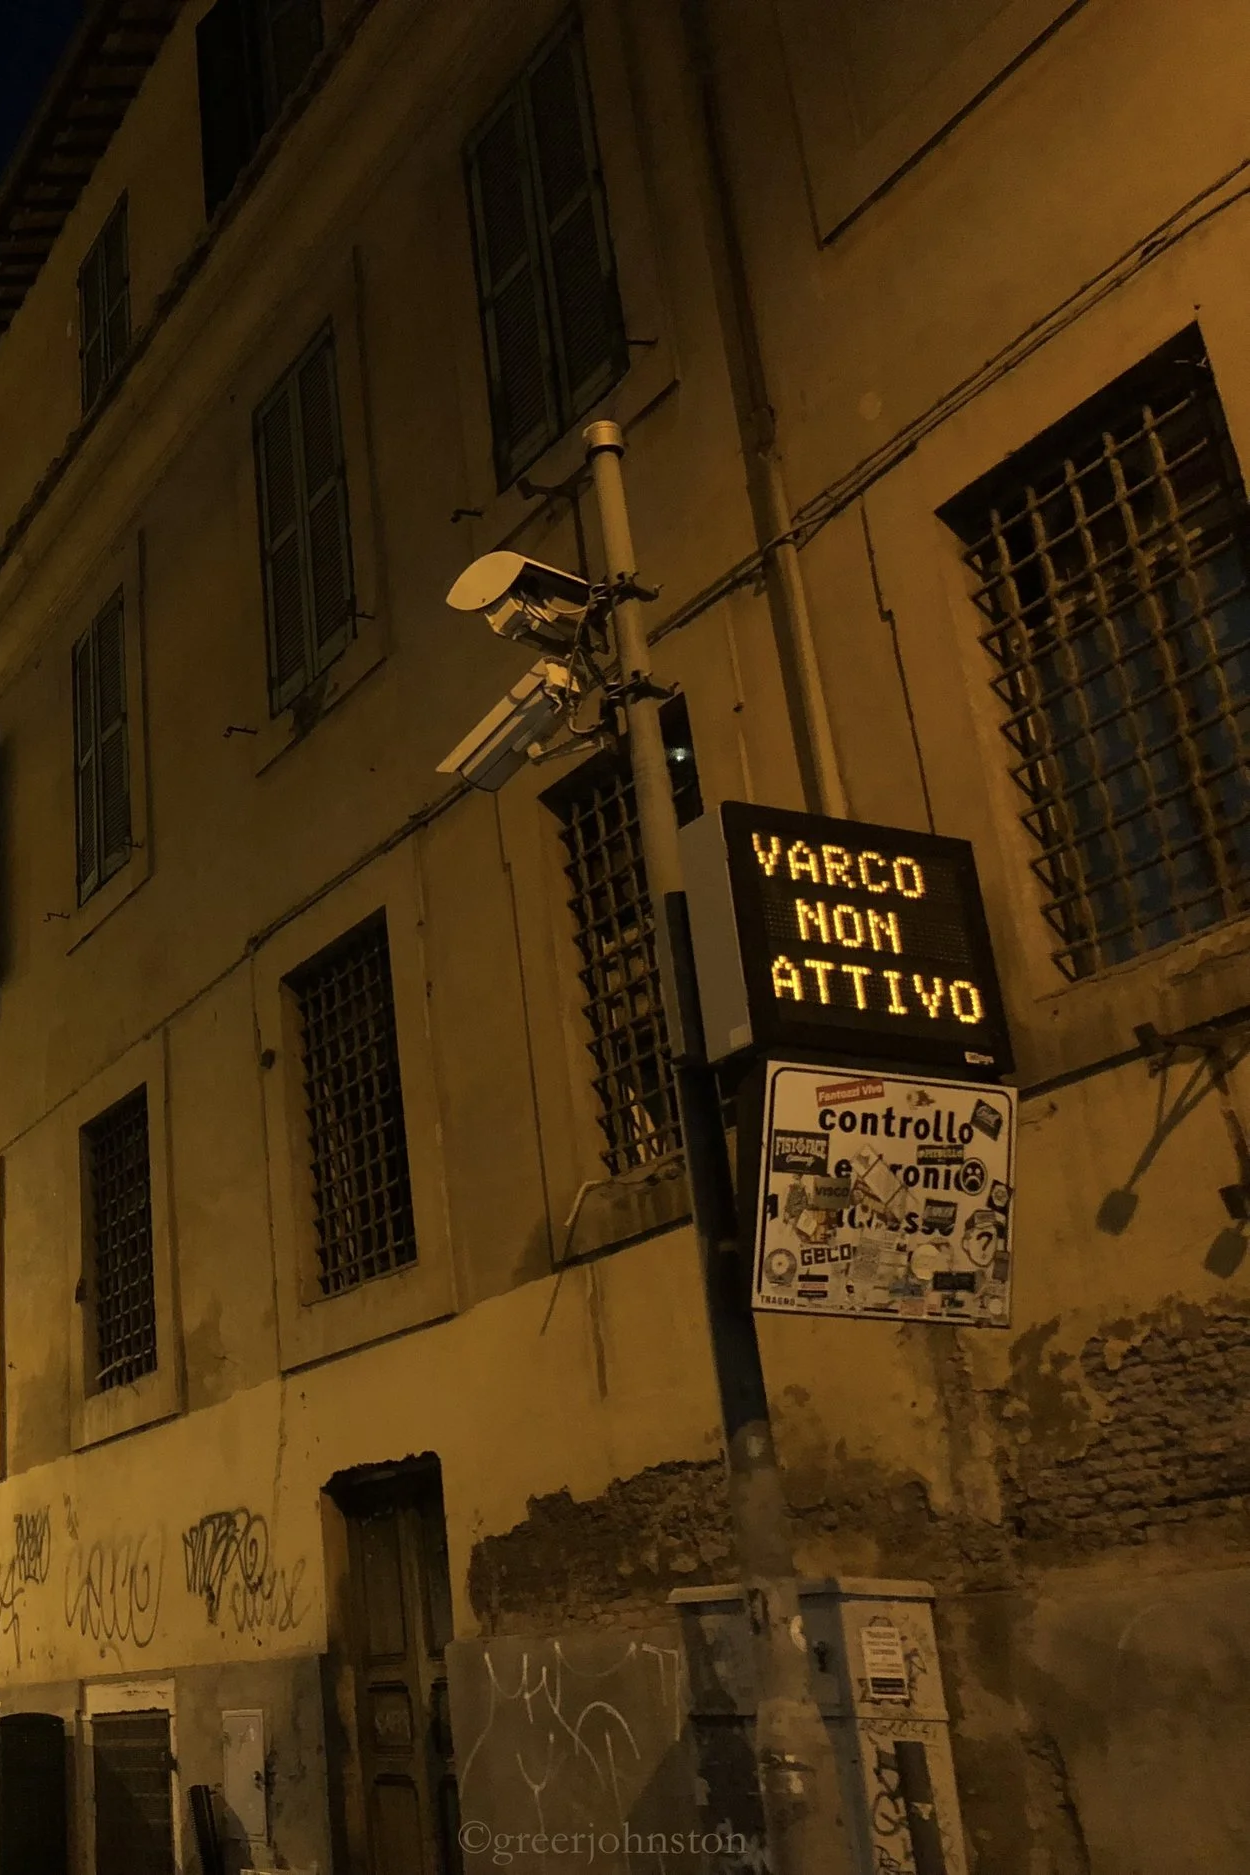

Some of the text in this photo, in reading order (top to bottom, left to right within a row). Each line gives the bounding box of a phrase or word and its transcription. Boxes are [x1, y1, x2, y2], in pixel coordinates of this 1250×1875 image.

[752, 832, 926, 899] VARCO
[795, 898, 903, 954] NON
[771, 955, 985, 1024] ATTIVO
[818, 1106, 974, 1144] controllo
